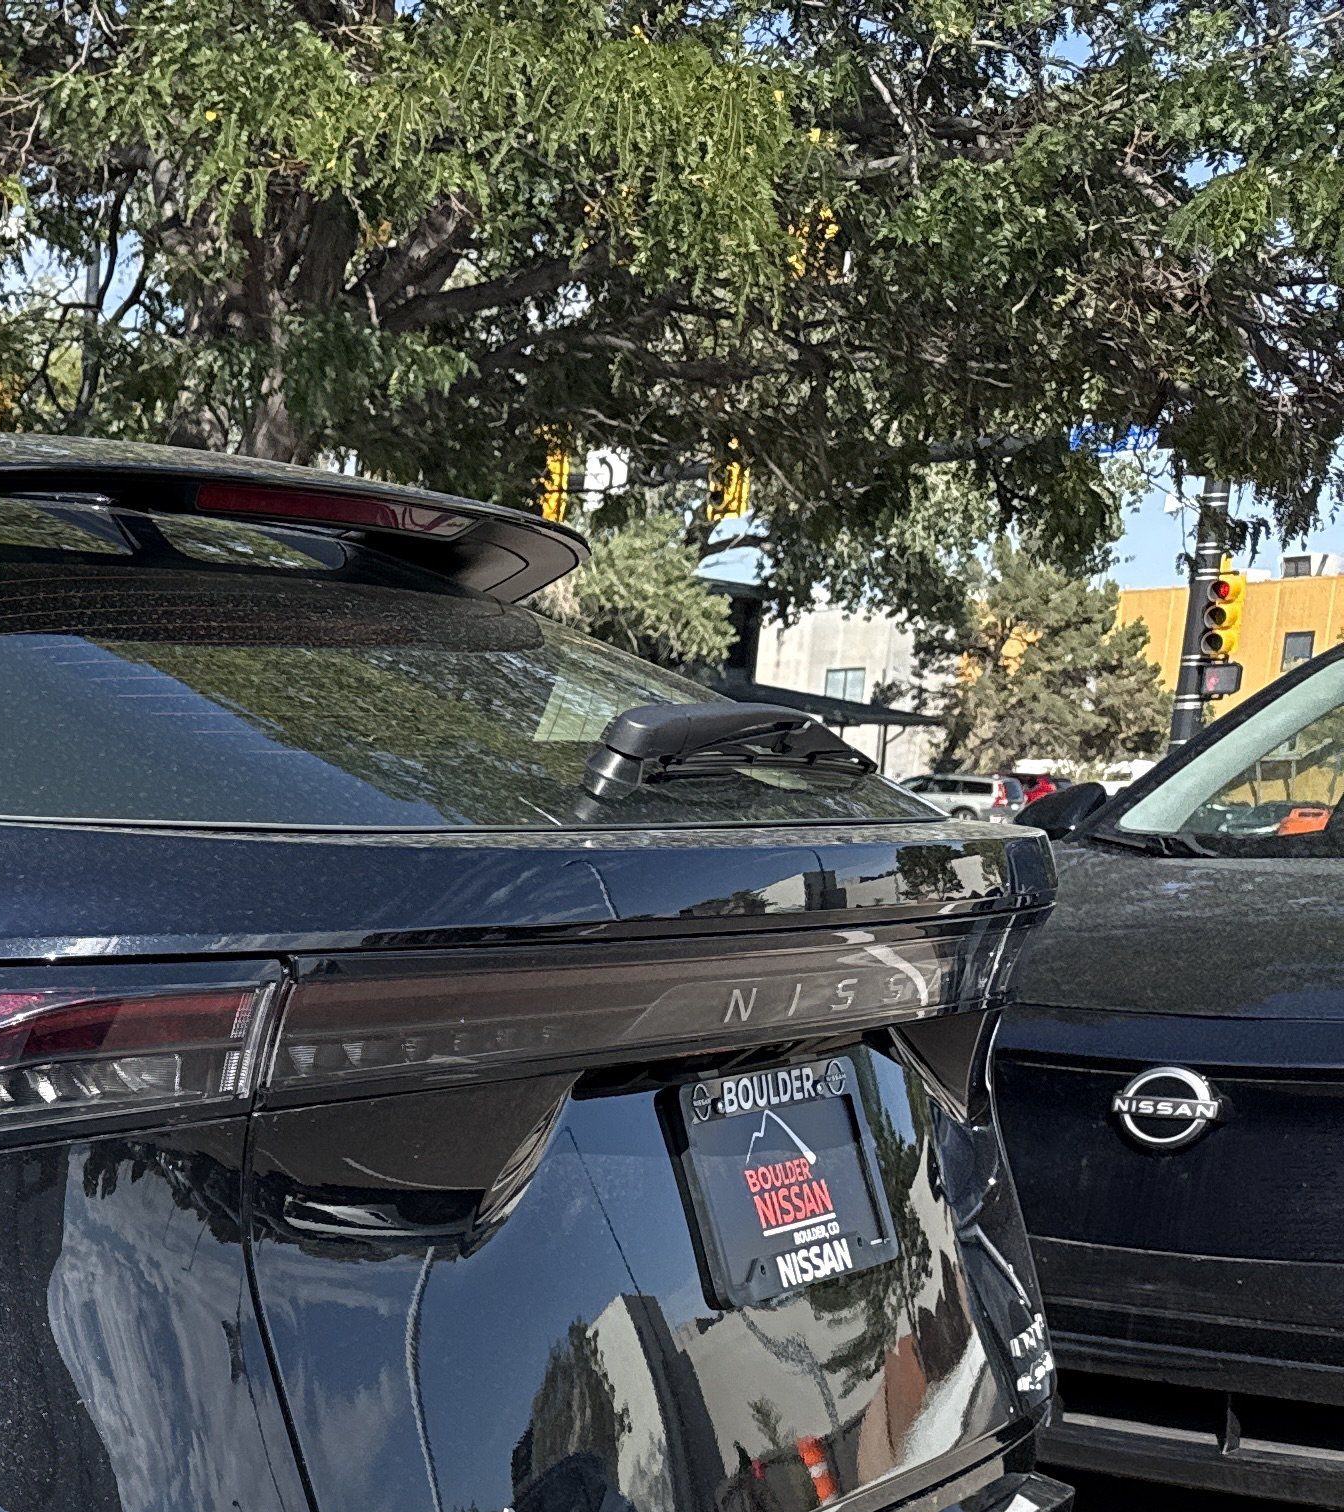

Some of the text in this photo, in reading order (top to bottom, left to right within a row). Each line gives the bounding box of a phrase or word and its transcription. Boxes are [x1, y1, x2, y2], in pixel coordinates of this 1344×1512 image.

[723, 1067, 816, 1114] BOULDER
[1113, 1096, 1217, 1119] NISSAN
[744, 1157, 812, 1193] BOULDER
[753, 1178, 834, 1229] NISSAN
[776, 1237, 853, 1288] NISSAN
